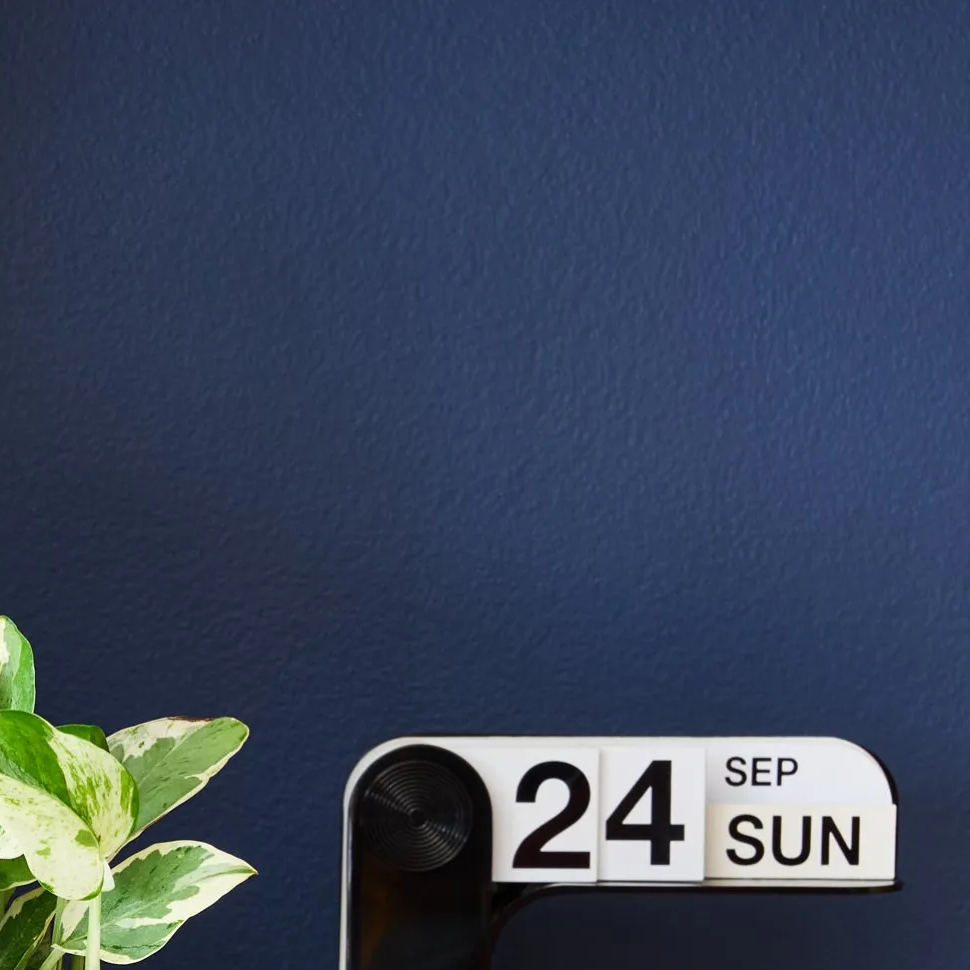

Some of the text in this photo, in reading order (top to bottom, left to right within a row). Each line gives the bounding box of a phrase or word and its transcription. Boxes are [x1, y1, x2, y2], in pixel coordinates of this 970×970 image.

[724, 756, 799, 787] SEP
[512, 760, 685, 870] 24
[725, 814, 861, 867] SUN
